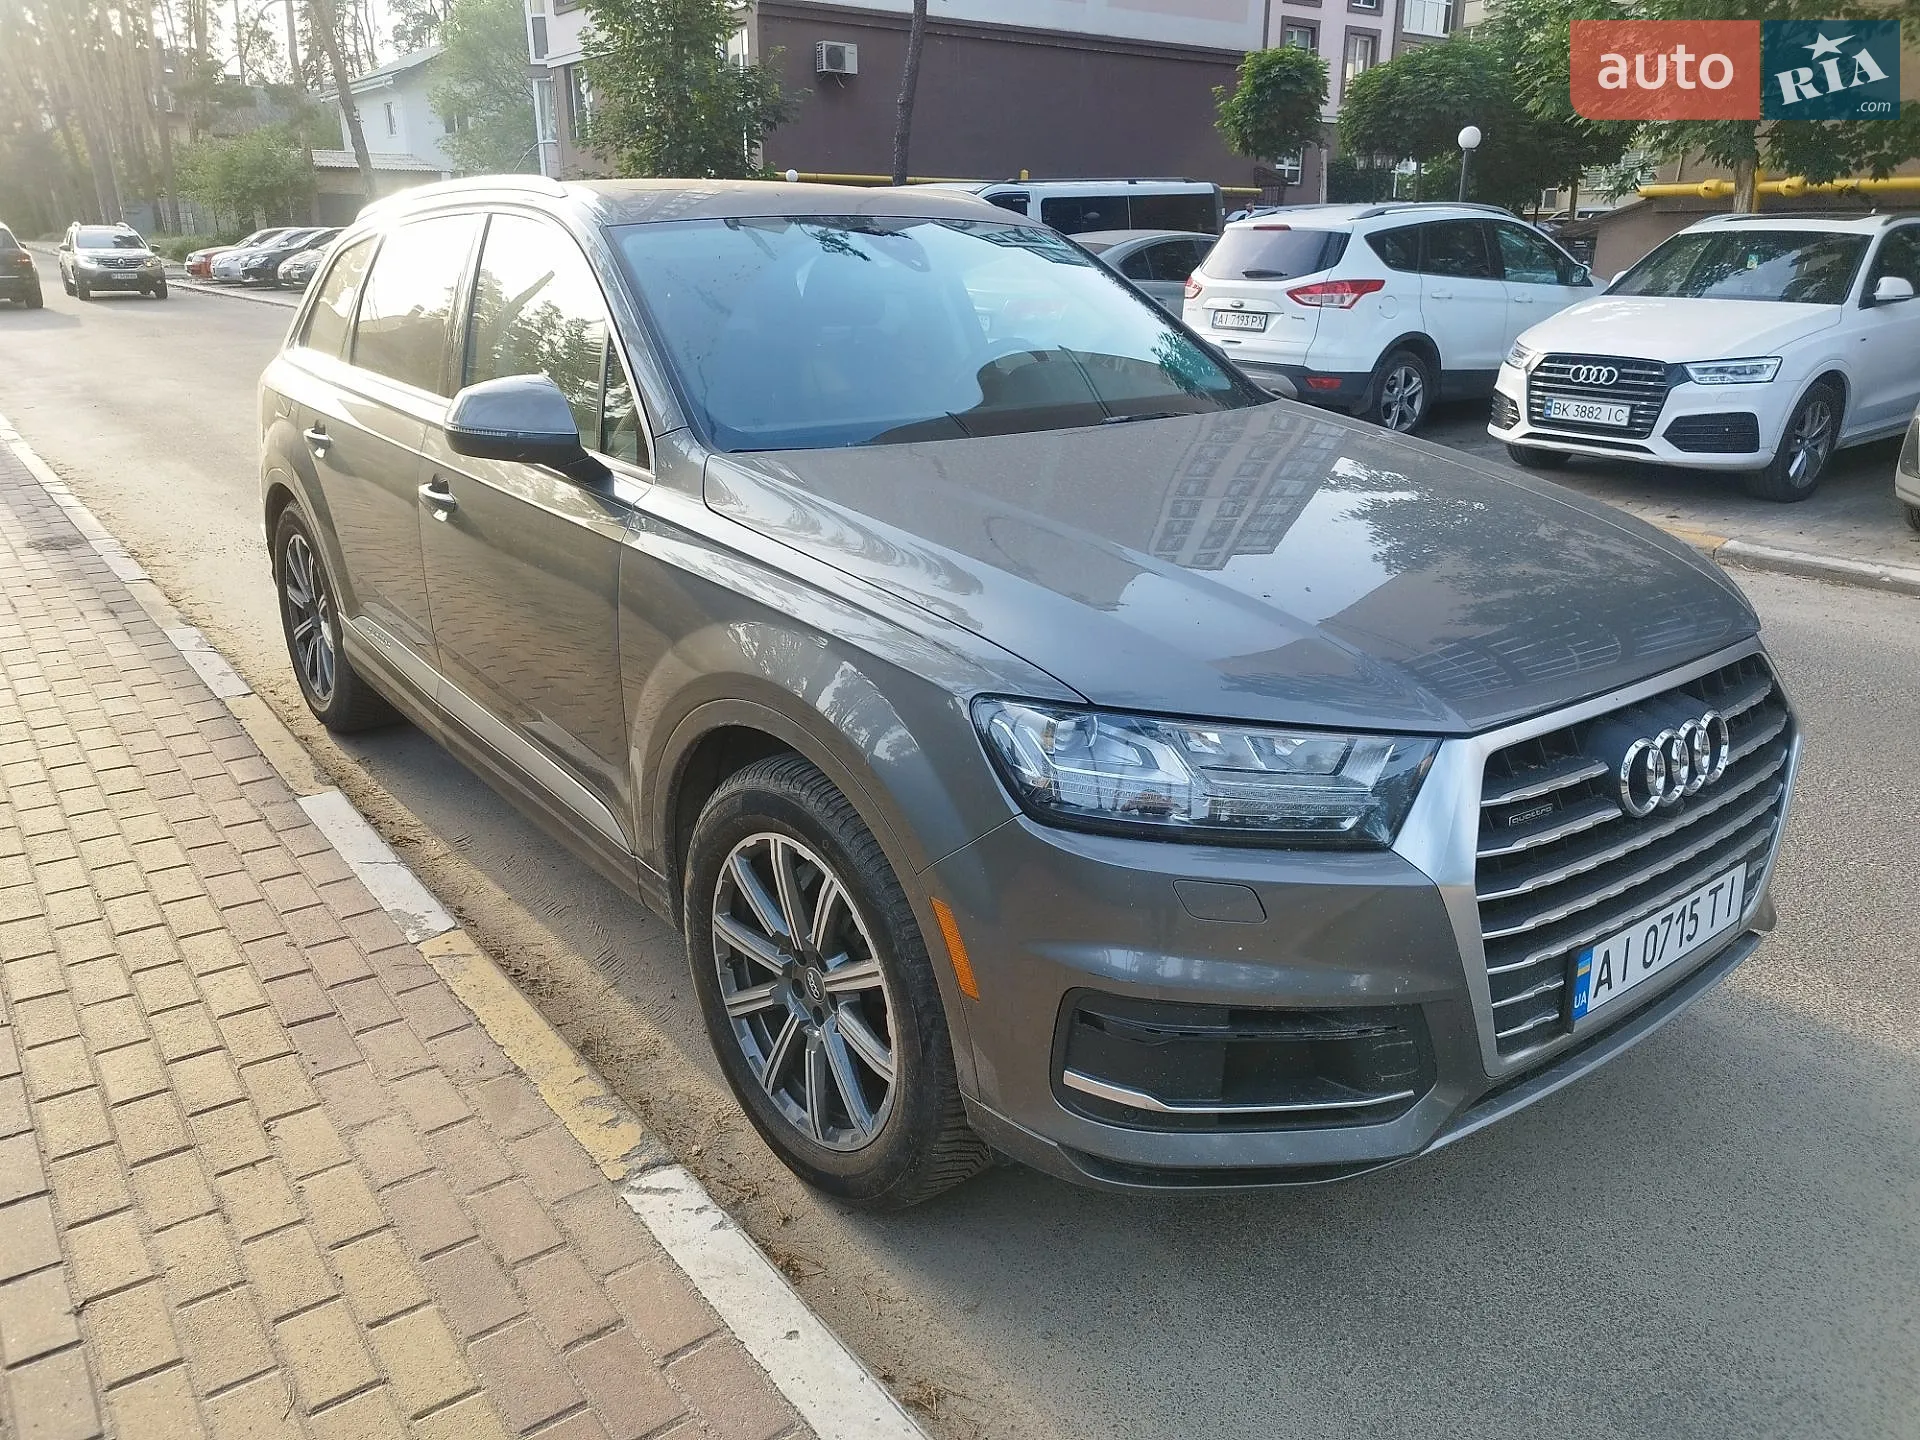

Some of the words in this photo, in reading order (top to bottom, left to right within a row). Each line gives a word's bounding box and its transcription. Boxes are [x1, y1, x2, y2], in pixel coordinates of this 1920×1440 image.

[1218, 313, 1229, 326] AI
[1231, 314, 1250, 327] 7193
[1250, 315, 1264, 328] PX
[1552, 402, 1571, 417] BK
[1573, 404, 1602, 420] 3882
[1607, 407, 1625, 422] IC
[1593, 936, 1631, 999] AI
[1642, 896, 1701, 969] 0715
[1708, 875, 1736, 929] TI
[1574, 990, 1587, 1009] UA
